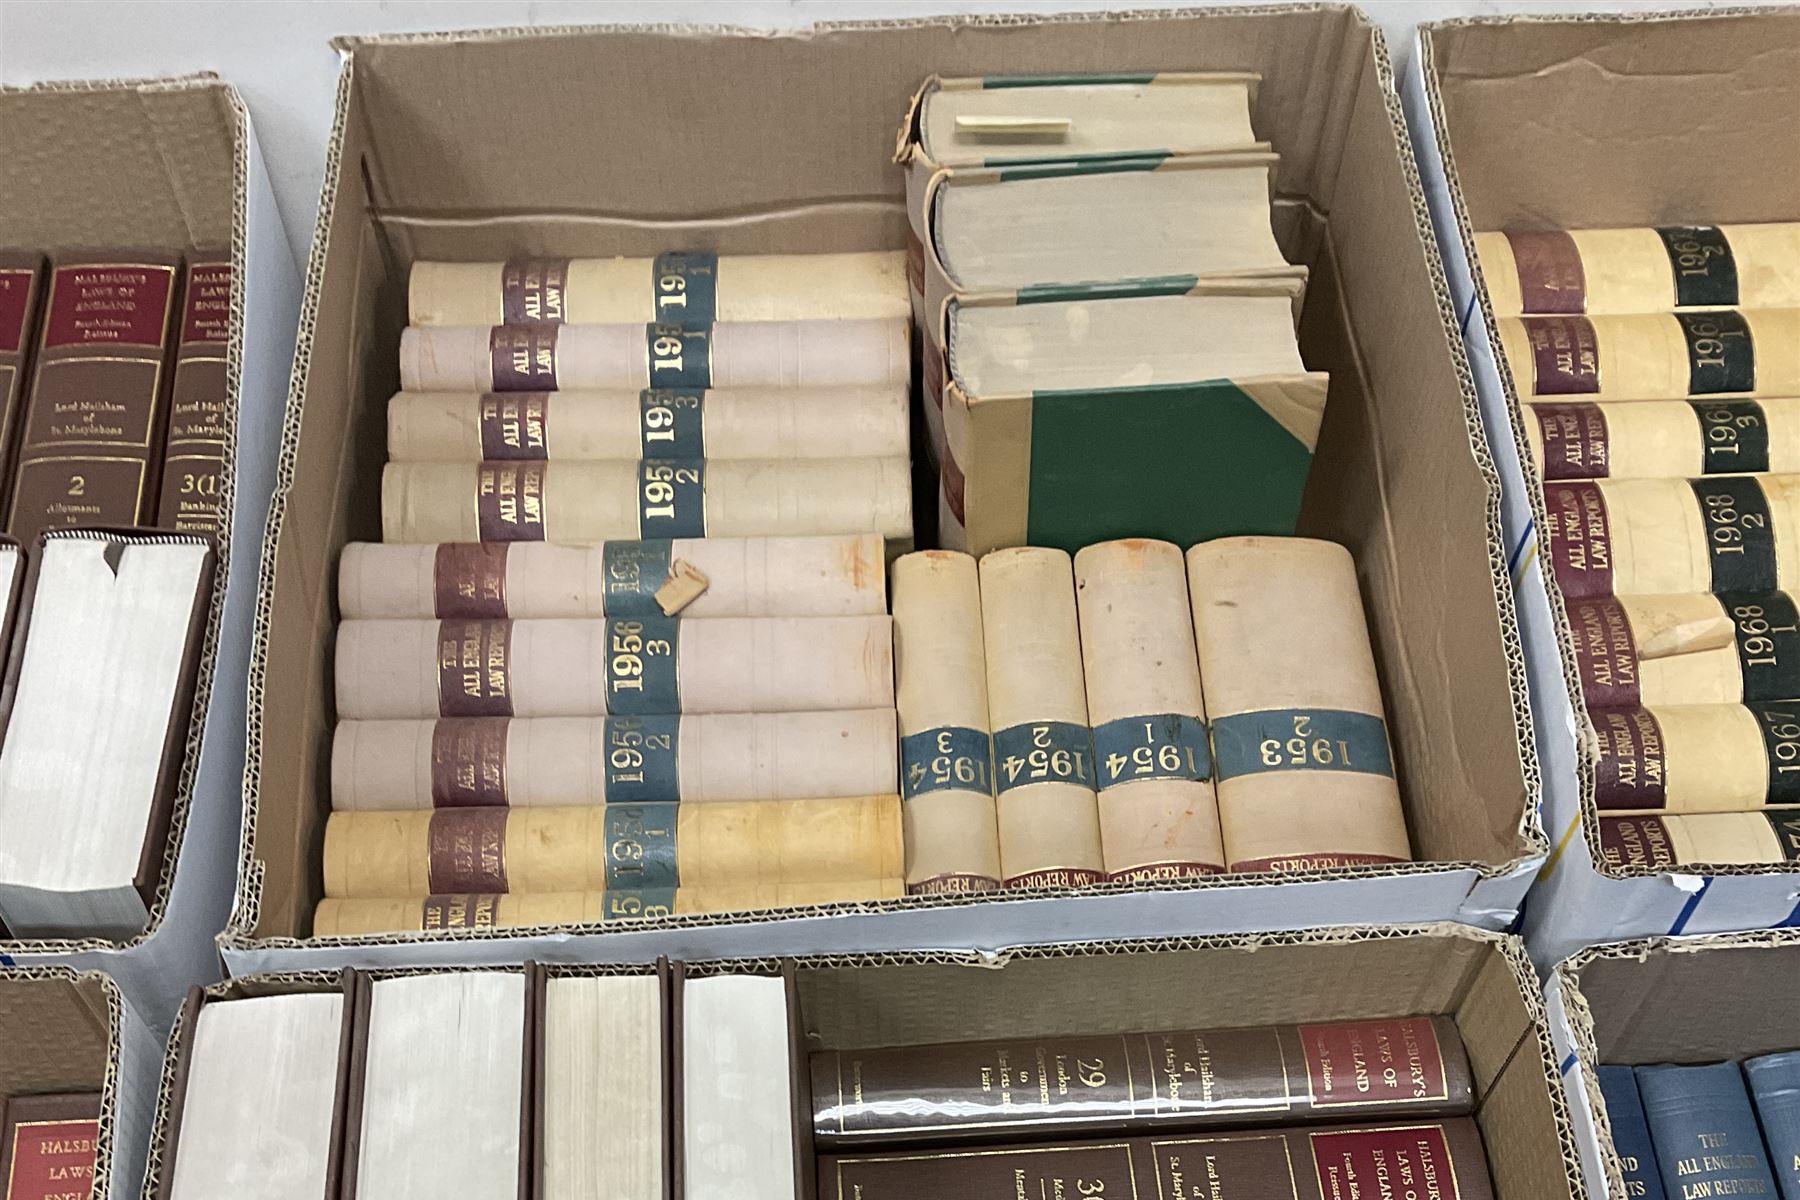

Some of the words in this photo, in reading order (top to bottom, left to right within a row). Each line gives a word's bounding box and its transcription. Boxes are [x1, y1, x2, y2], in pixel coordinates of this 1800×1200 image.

[676, 396, 698, 409] 3
[1737, 416, 1758, 428] 3
[1566, 442, 1583, 466] ALL
[1590, 439, 1605, 464] LAW
[68, 476, 85, 495] 2
[676, 468, 699, 484] 2
[501, 498, 517, 524] ALL
[1706, 494, 1744, 554] 1968
[1742, 514, 1764, 528] 2
[1570, 544, 1586, 570] ALL
[1591, 539, 1608, 568] LAW
[1581, 606, 1606, 656] ENGLAND
[1602, 605, 1629, 650] REPORTS
[1735, 606, 1777, 666] 1968
[1772, 624, 1796, 633] 1
[613, 621, 644, 693] 1956
[647, 640, 670, 657] 3
[489, 668, 505, 697] LAW
[1594, 660, 1612, 685] ALL
[1617, 655, 1634, 684] LAW
[464, 670, 481, 697] ALL
[1033, 727, 1051, 747] 2
[1145, 723, 1154, 744] 1
[1293, 716, 1312, 736] 2
[646, 734, 670, 749] 2
[937, 732, 953, 753] 3
[1260, 739, 1351, 766] 1953
[909, 756, 986, 790] 1954
[1003, 750, 1087, 783] 1954
[1105, 745, 1196, 779] 1954
[1619, 760, 1636, 788] ALL
[1645, 758, 1661, 786] LAW
[1077, 1059, 1106, 1088] 29
[1396, 1150, 1413, 1185] LAWS
[1678, 1159, 1701, 1176] ALL
[1683, 1183, 1713, 1200] LAW
